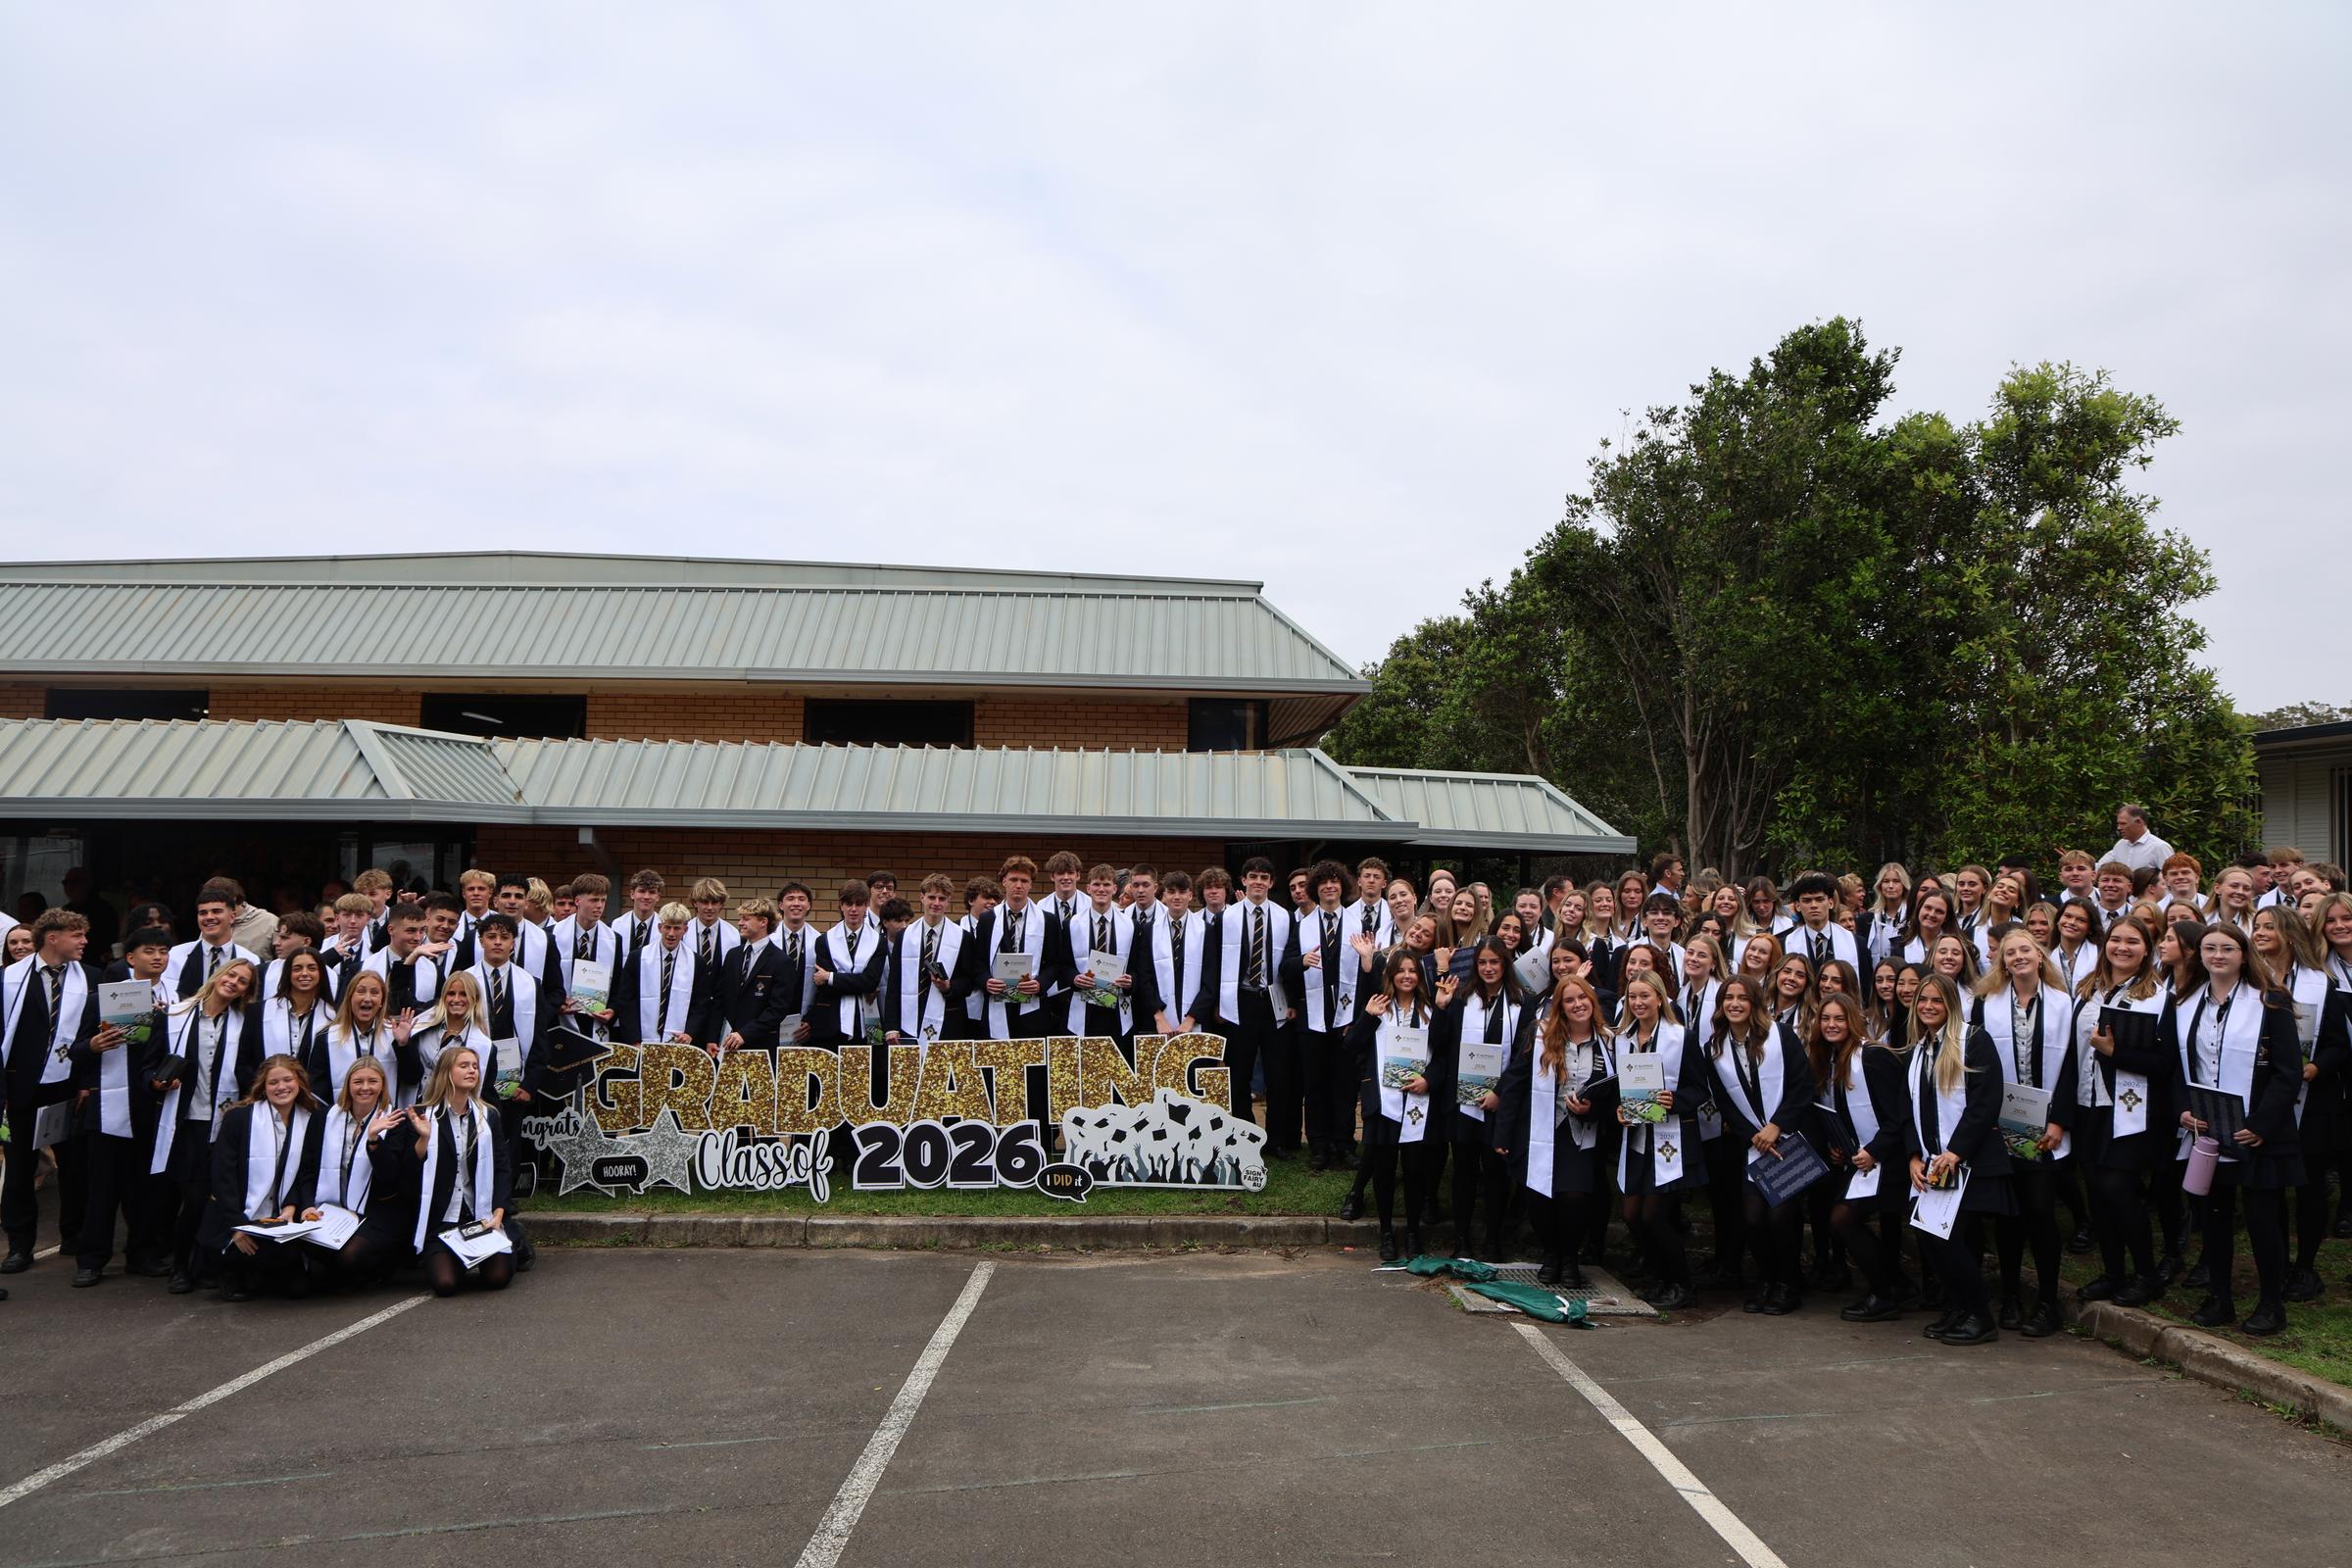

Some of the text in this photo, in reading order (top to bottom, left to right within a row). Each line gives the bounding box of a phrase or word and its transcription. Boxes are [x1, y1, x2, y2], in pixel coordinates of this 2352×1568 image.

[583, 1033, 1232, 1135] GRADUATING
[520, 1112, 580, 1145] ngrats
[603, 1165, 637, 1177] HOORAY!
[698, 1122, 1043, 1201] Class of 2026
[1046, 1173, 1083, 1187] I DID it
